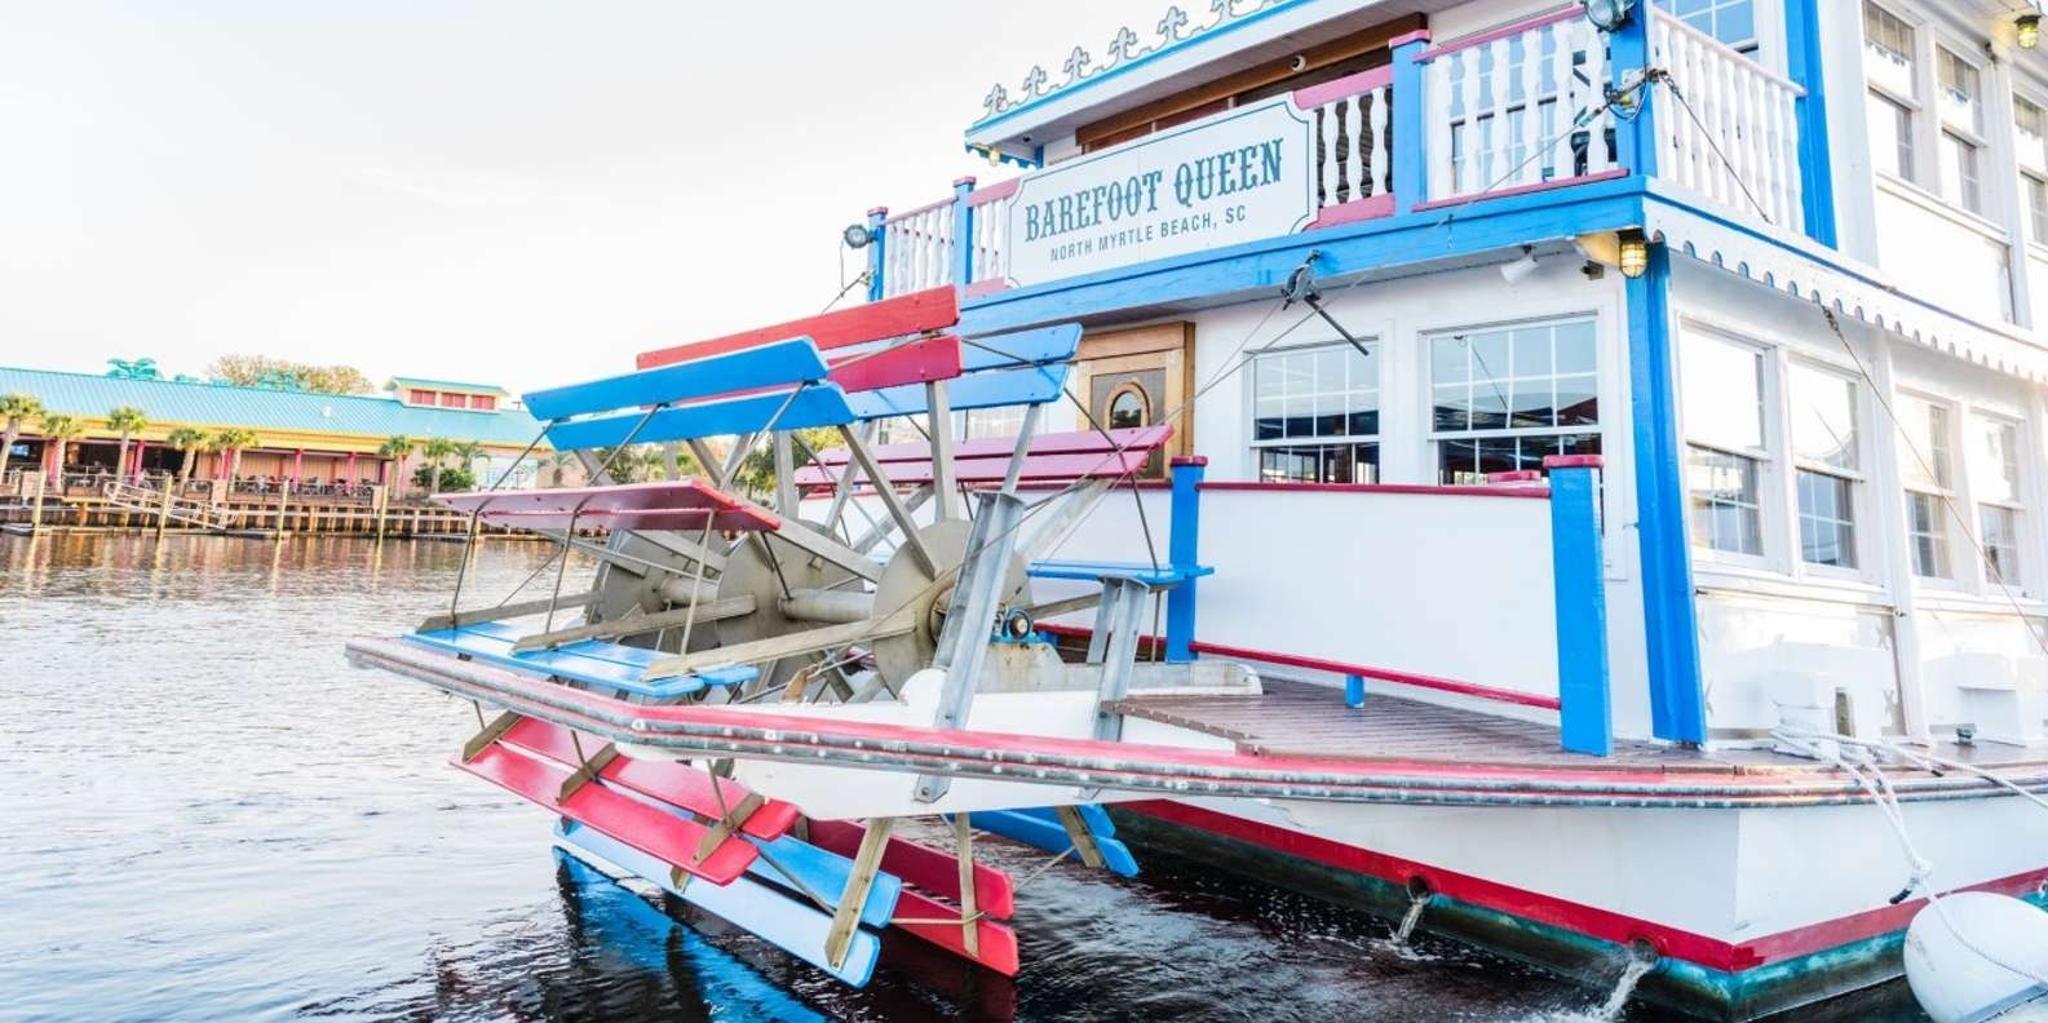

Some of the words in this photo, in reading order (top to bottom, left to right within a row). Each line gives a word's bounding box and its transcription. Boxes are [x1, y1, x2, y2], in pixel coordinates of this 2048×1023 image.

[1025, 168, 1163, 242] BAREFOOT
[1174, 137, 1284, 207] QUEEN
[1051, 240, 1092, 262] NORTH
[1099, 226, 1153, 250] MYRTLE
[1161, 212, 1217, 236] BEACH,
[1226, 205, 1246, 224] SC
